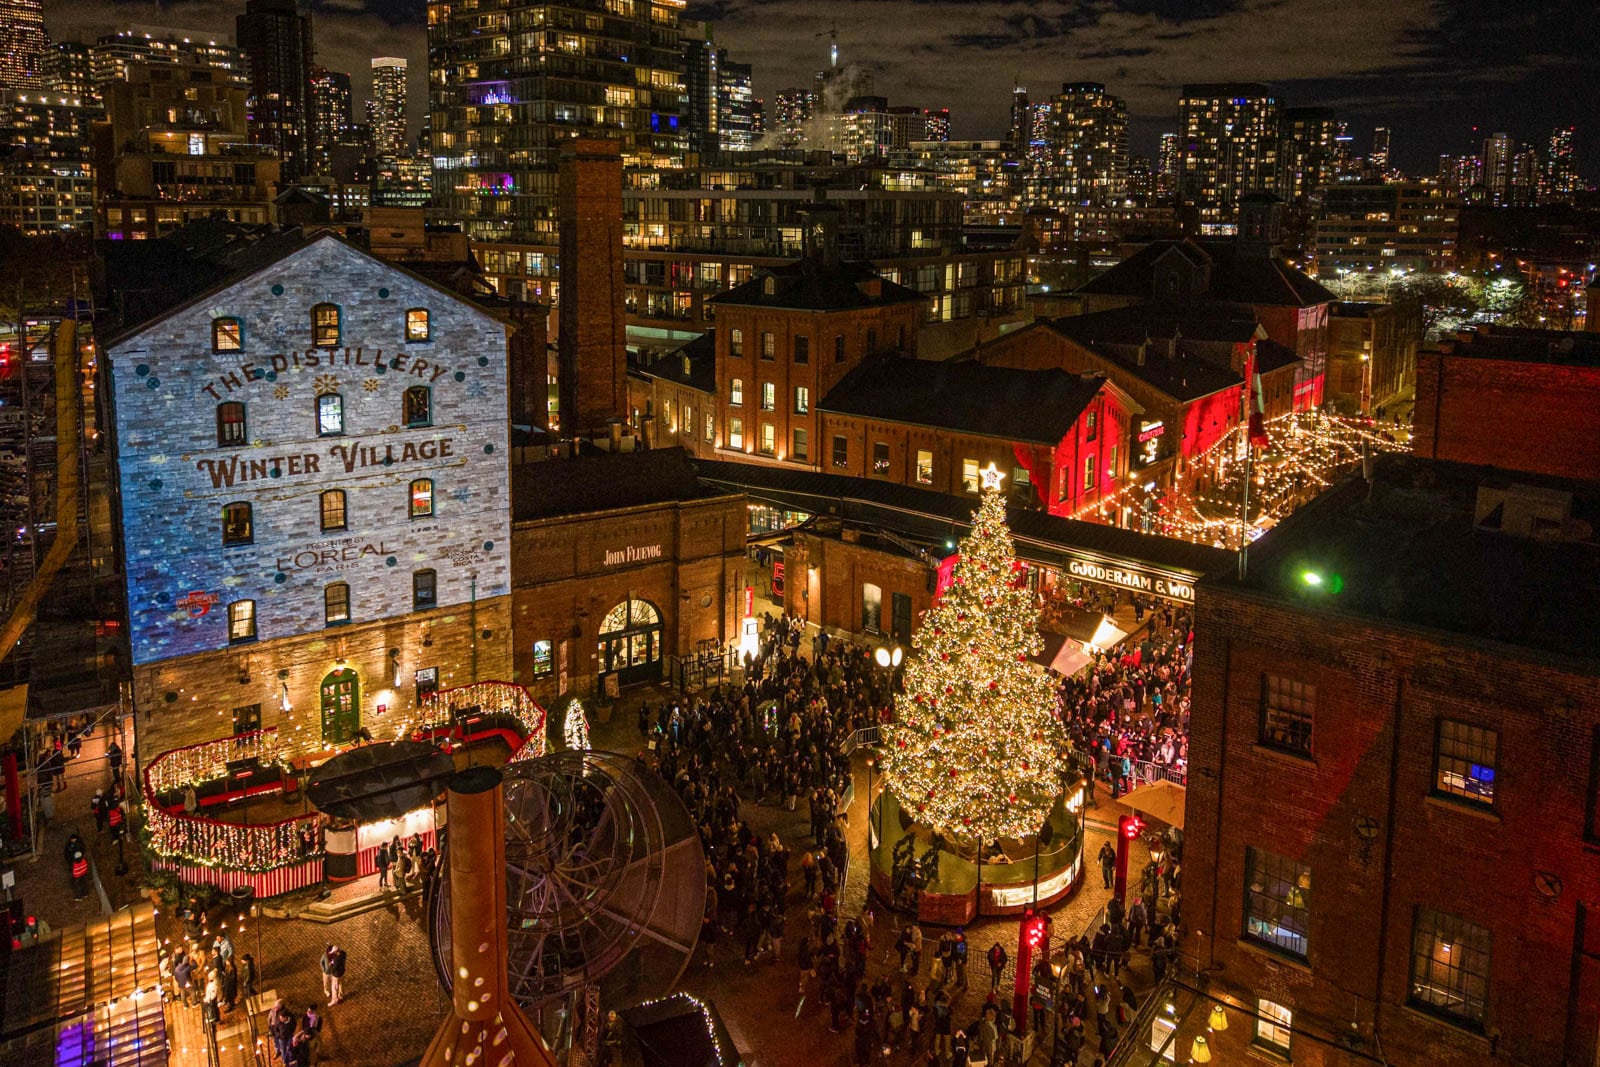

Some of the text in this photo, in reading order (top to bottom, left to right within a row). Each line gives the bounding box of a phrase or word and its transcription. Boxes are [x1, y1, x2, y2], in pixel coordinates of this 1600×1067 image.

[202, 348, 447, 400] THE DISTILLERY
[197, 438, 454, 489] WINTER VILLAGE
[316, 562, 360, 573] PARIS
[603, 544, 662, 567] JOHN FLUEVOG
[1069, 561, 1152, 590] GOODERHAM
[1155, 580, 1167, 594] &
